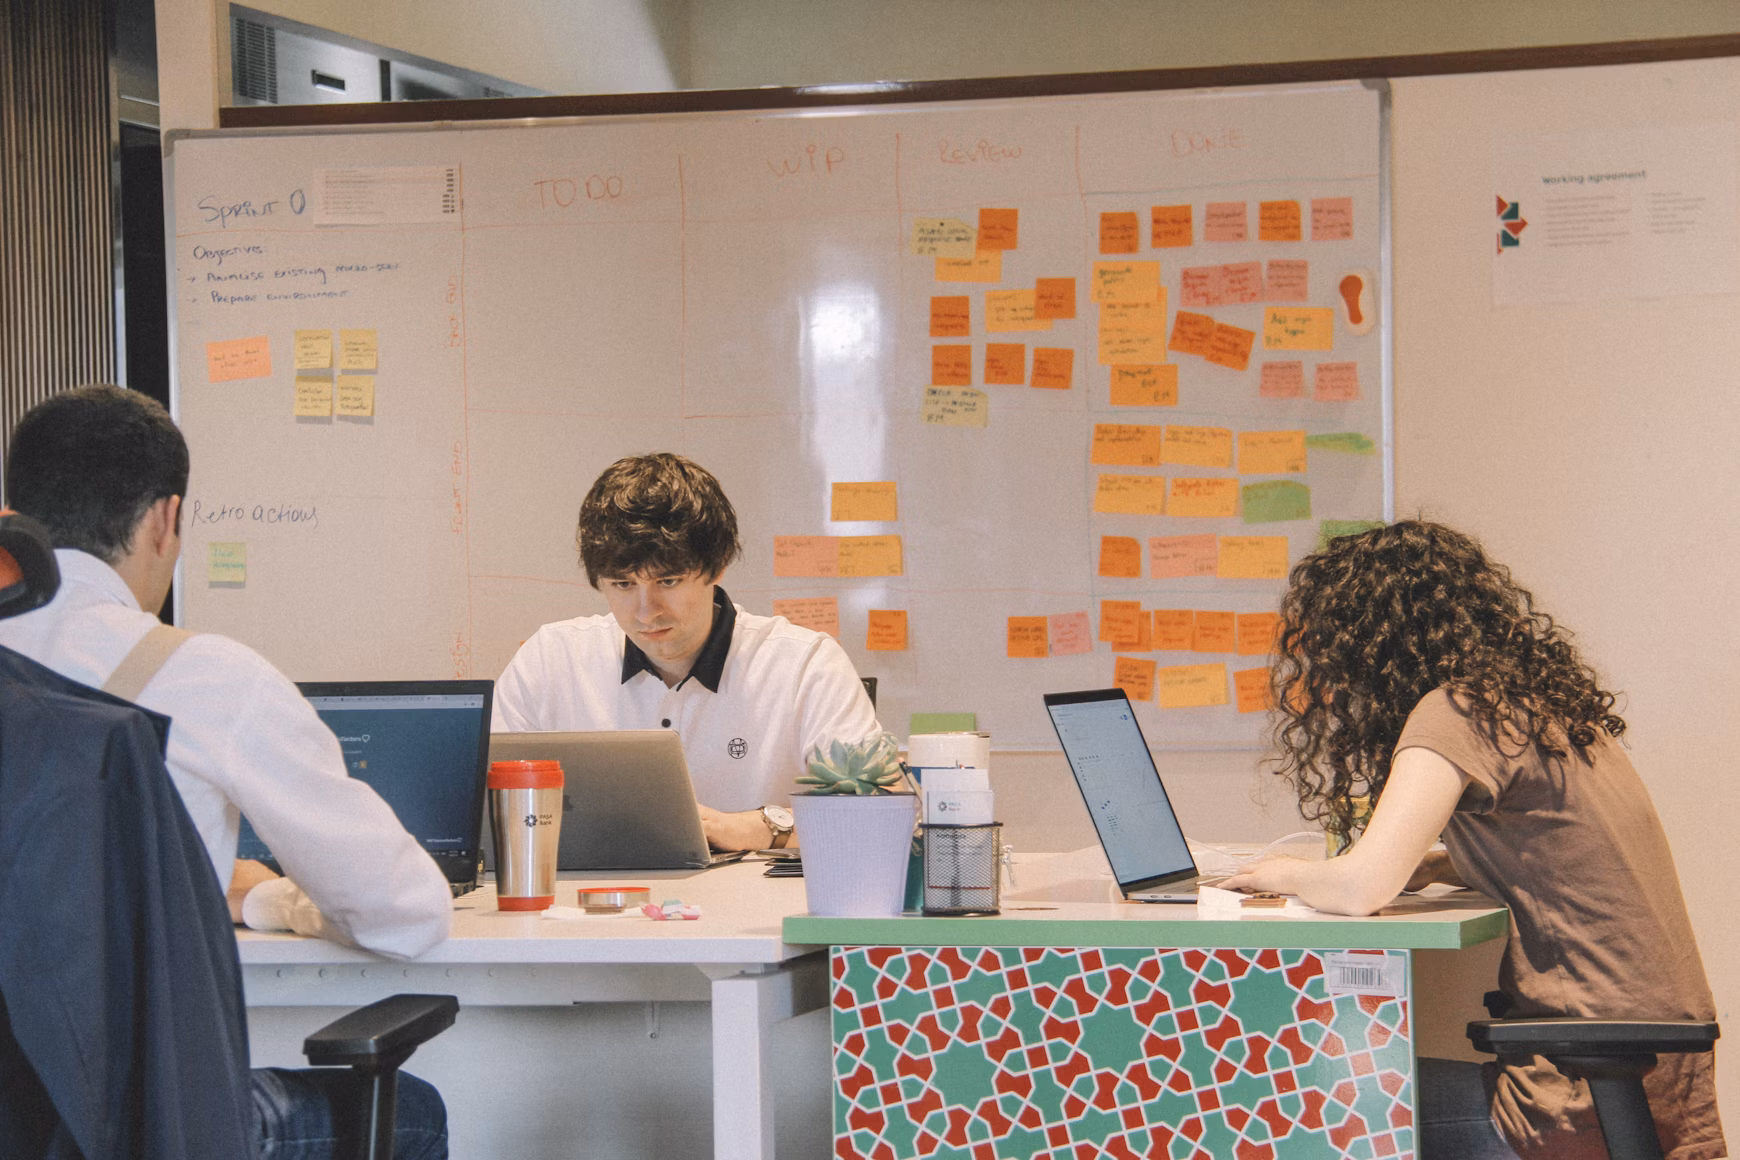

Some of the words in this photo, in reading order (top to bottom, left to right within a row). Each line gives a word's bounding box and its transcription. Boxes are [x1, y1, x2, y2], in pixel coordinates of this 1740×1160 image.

[534, 179, 577, 209] TO
[585, 175, 623, 200] DO
[1541, 174, 1585, 186] Working
[1587, 170, 1647, 183] agreement
[191, 500, 245, 528] Retro
[251, 504, 320, 529] actions
